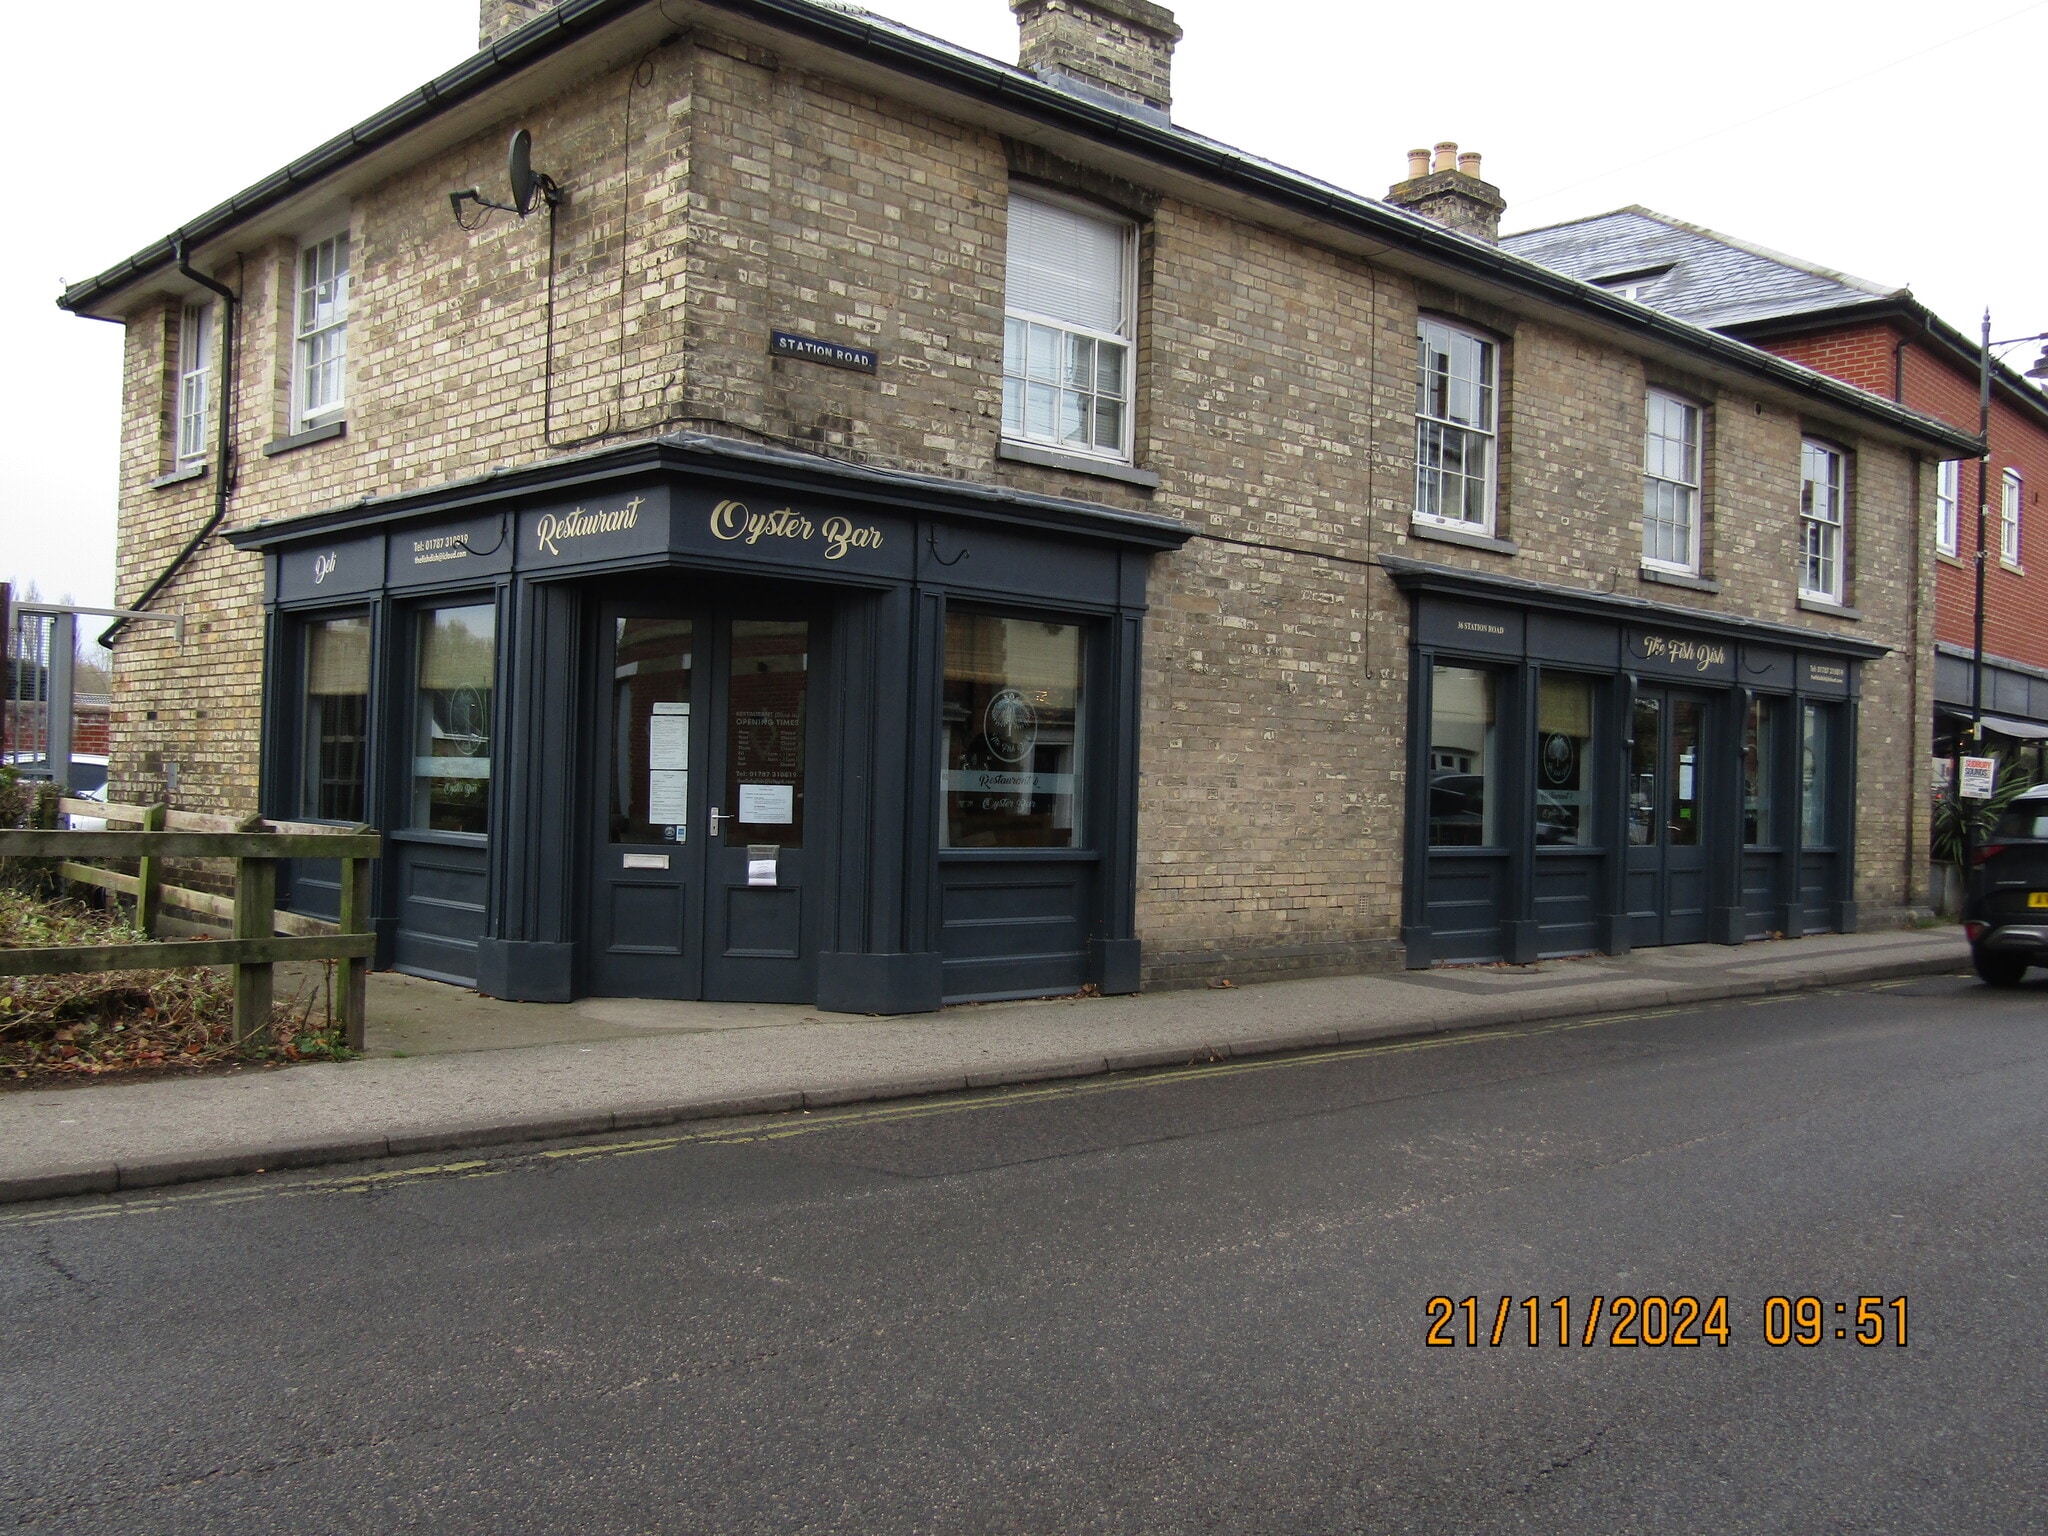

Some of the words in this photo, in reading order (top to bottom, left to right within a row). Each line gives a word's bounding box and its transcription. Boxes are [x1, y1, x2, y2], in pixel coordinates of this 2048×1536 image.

[779, 337, 832, 357] STATION
[537, 496, 646, 556] Restaurant
[710, 500, 815, 545] Oyster
[821, 516, 884, 560] Bar
[413, 540, 425, 552] Tel:
[425, 538, 444, 551] 01787
[315, 551, 337, 584] Deli
[1464, 622, 1488, 632] STATION
[1488, 625, 1505, 634] ROAD
[1644, 636, 1666, 660] The
[1668, 639, 1695, 663] Fish
[1696, 644, 1726, 672] Dish
[735, 718, 775, 726] OPENING
[979, 774, 1032, 790] Restaurant
